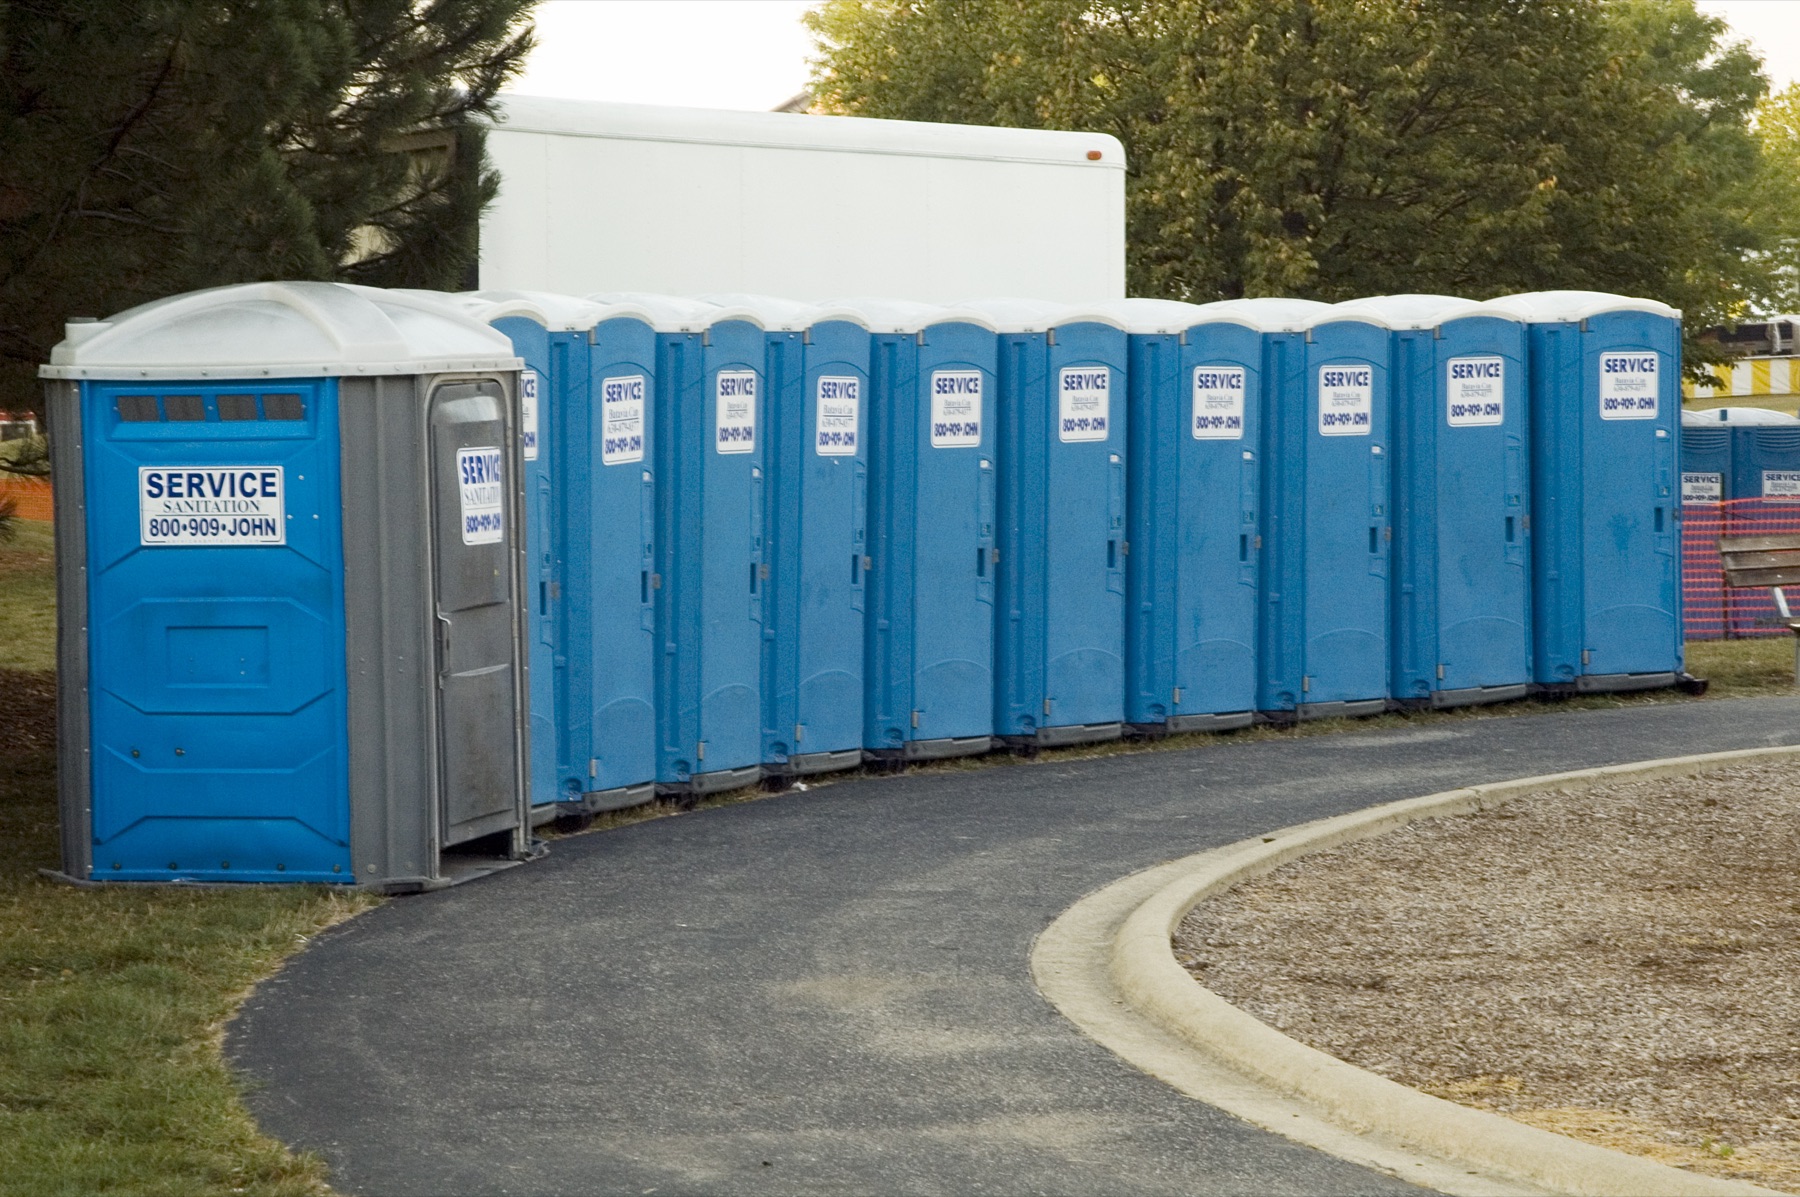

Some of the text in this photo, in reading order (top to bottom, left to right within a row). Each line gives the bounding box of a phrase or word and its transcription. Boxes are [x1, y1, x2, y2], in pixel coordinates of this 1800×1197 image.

[1452, 363, 1501, 379] SERVICE
[1604, 358, 1656, 373] SERVICE
[719, 377, 754, 397] SERVICE
[935, 377, 979, 395] SERVICE
[1063, 373, 1107, 391] SERVICE
[1197, 373, 1242, 390] SERVICE
[1323, 371, 1369, 388] SERVICE
[605, 381, 643, 403] SERVICE
[820, 381, 857, 400] SERVICE
[460, 454, 500, 485] SERVIC
[146, 472, 277, 498] SERVICE
[1683, 475, 1720, 484] SERVICE
[162, 499, 260, 513] SANITATION
